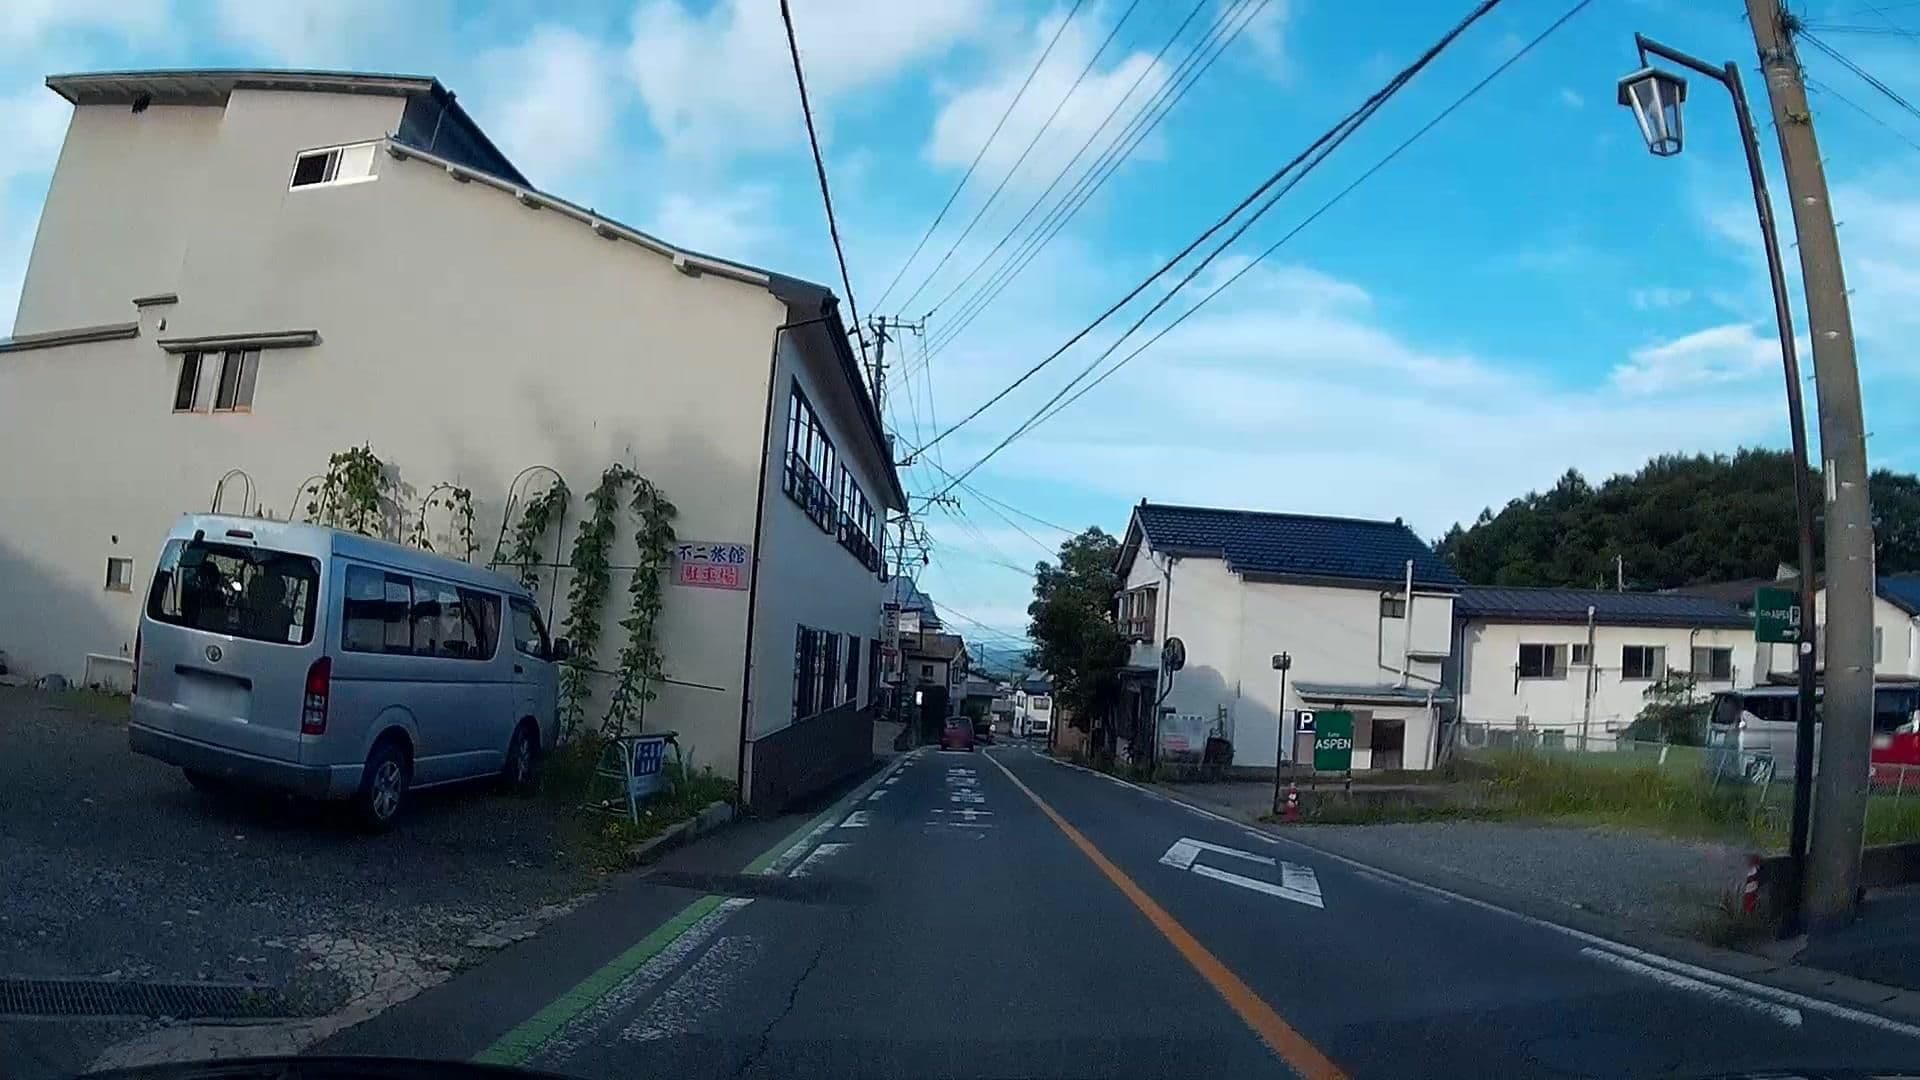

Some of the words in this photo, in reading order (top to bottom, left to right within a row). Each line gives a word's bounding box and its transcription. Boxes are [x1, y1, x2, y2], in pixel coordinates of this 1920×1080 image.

[679, 544, 746, 564] 不二旅館
[685, 566, 737, 585] 駐車場
[1300, 711, 1313, 730] P
[1315, 738, 1352, 750] ASPEN
